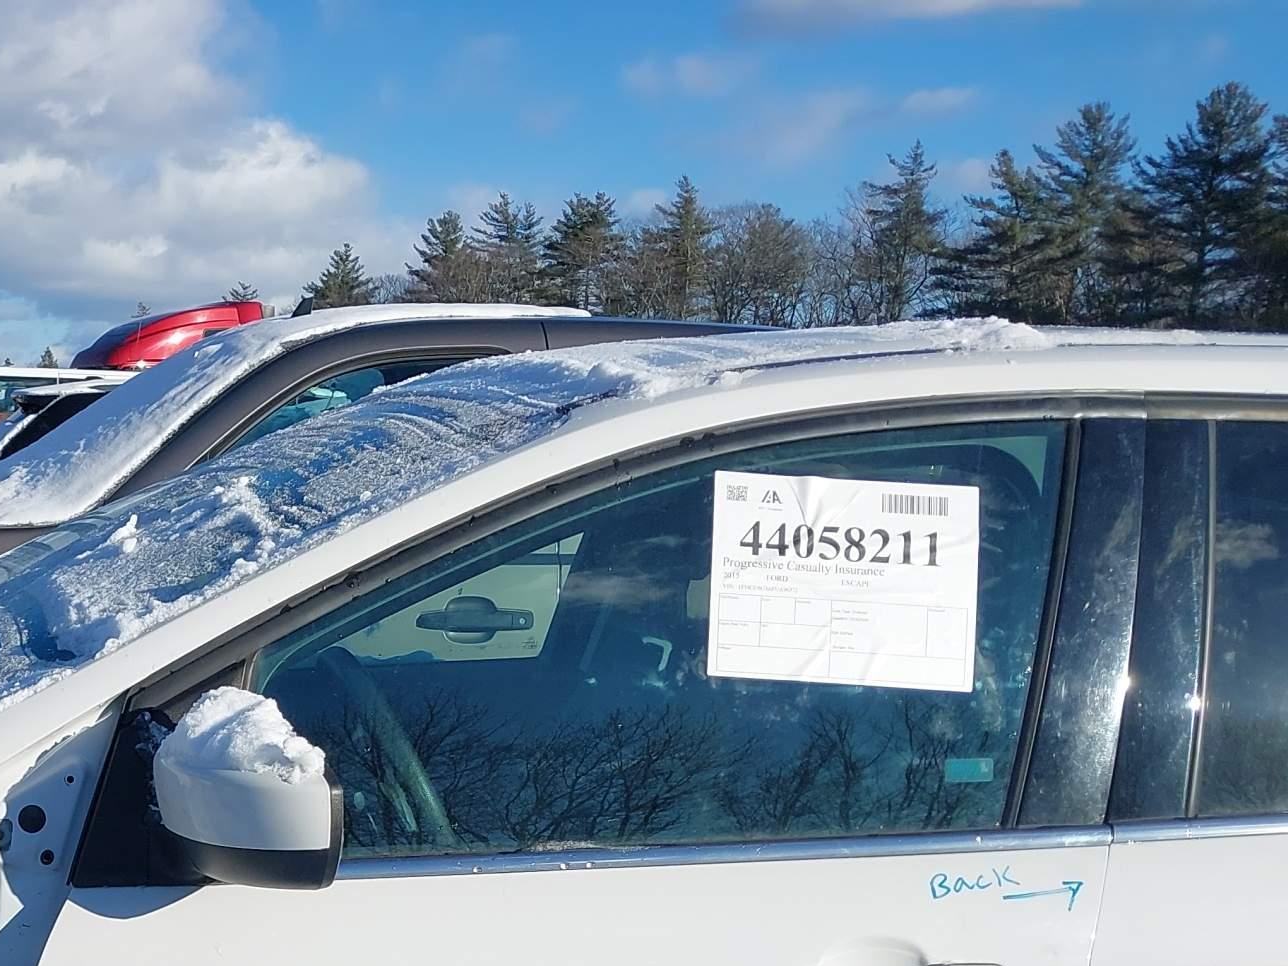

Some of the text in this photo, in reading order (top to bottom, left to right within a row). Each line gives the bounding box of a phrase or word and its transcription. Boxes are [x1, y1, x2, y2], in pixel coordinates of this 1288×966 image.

[740, 520, 943, 568] 44058211
[722, 556, 886, 577] Progressive Casualty Insurance
[930, 865, 1020, 900] Back
